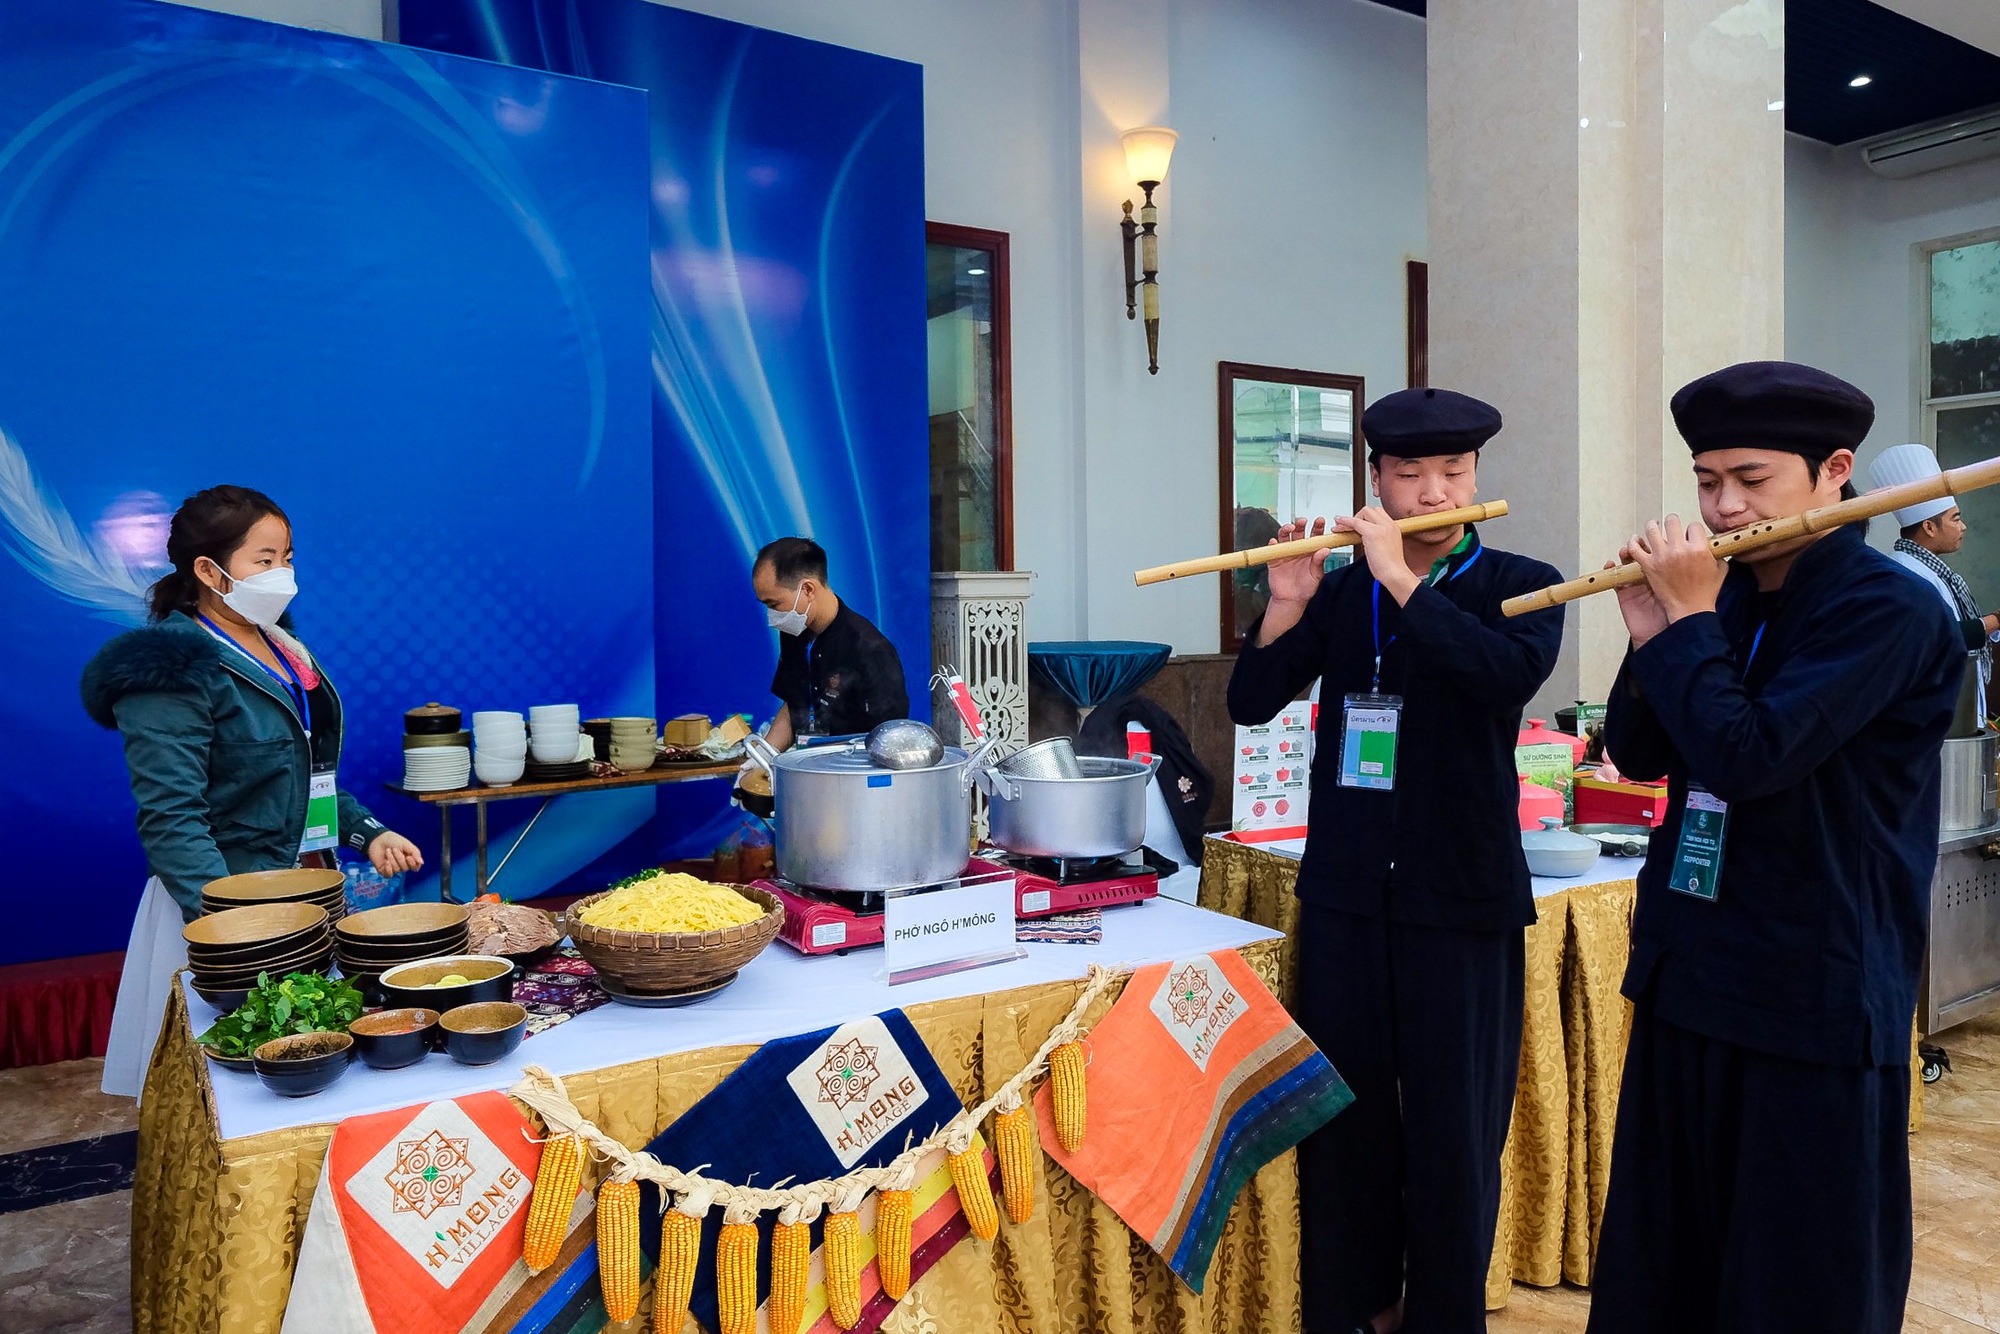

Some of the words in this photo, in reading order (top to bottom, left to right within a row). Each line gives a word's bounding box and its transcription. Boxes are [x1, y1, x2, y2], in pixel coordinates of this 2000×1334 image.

[1682, 855, 1711, 867] SUPPORTER
[923, 918, 949, 935] NGÔ
[1205, 1008, 1237, 1055] VILLAGE
[854, 1100, 911, 1149] VILLAGE
[451, 1194, 519, 1264] VILLAGE
